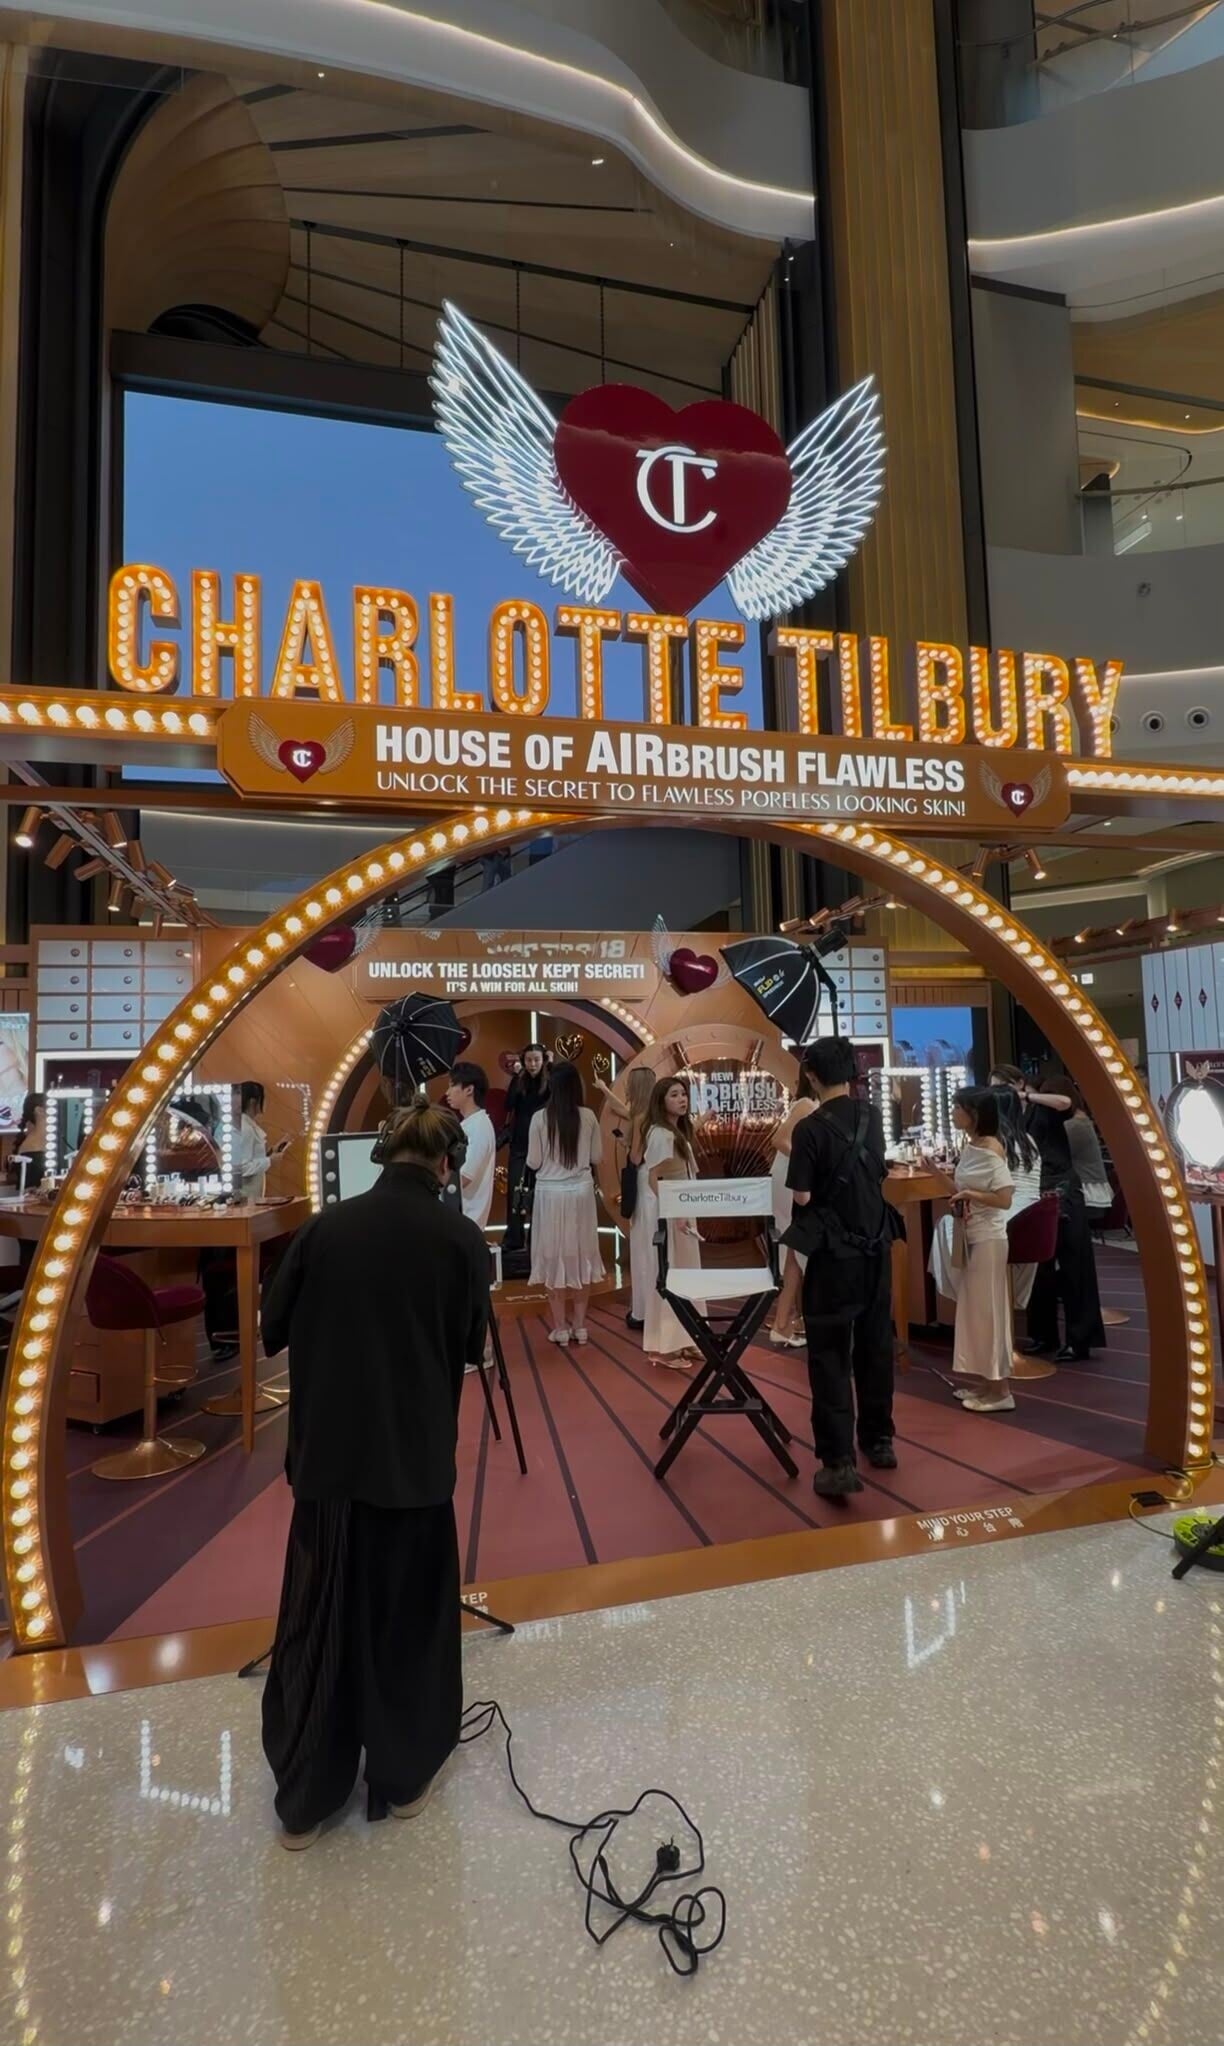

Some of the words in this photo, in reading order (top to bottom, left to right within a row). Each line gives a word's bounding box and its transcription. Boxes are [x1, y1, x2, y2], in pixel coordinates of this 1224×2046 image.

[108, 563, 749, 732] CHARLOTTE
[768, 627, 1124, 758] TILBURY
[376, 725, 511, 769] HOUSE
[524, 734, 573, 771] OF
[586, 731, 785, 783] AIRBRUSH
[798, 751, 965, 793] FLAWLESS
[377, 771, 469, 794] UNLOCK
[476, 776, 518, 797] THE
[525, 778, 600, 799] SECRET
[606, 782, 635, 801] TO
[642, 784, 735, 807] FLAWLESS
[741, 789, 830, 811] PORELESS
[836, 794, 917, 815] LOOKING
[923, 799, 966, 817] SKIN!
[368, 962, 434, 979] UNLOCK
[437, 963, 468, 979] THE
[472, 963, 538, 979] LOOSELY
[542, 963, 581, 979] KEPT
[584, 963, 645, 979] SECRET!
[446, 981, 467, 993] IT'S
[469, 982, 478, 993] A
[480, 982, 501, 993] WIN
[504, 982, 526, 993] FOR
[528, 982, 548, 993] ALL
[550, 981, 579, 993] SKIN!
[916, 1516, 950, 1530] MIND
[948, 1511, 985, 1524] YOUR
[983, 1507, 1013, 1519] STEP
[460, 1591, 488, 1605] TEP
